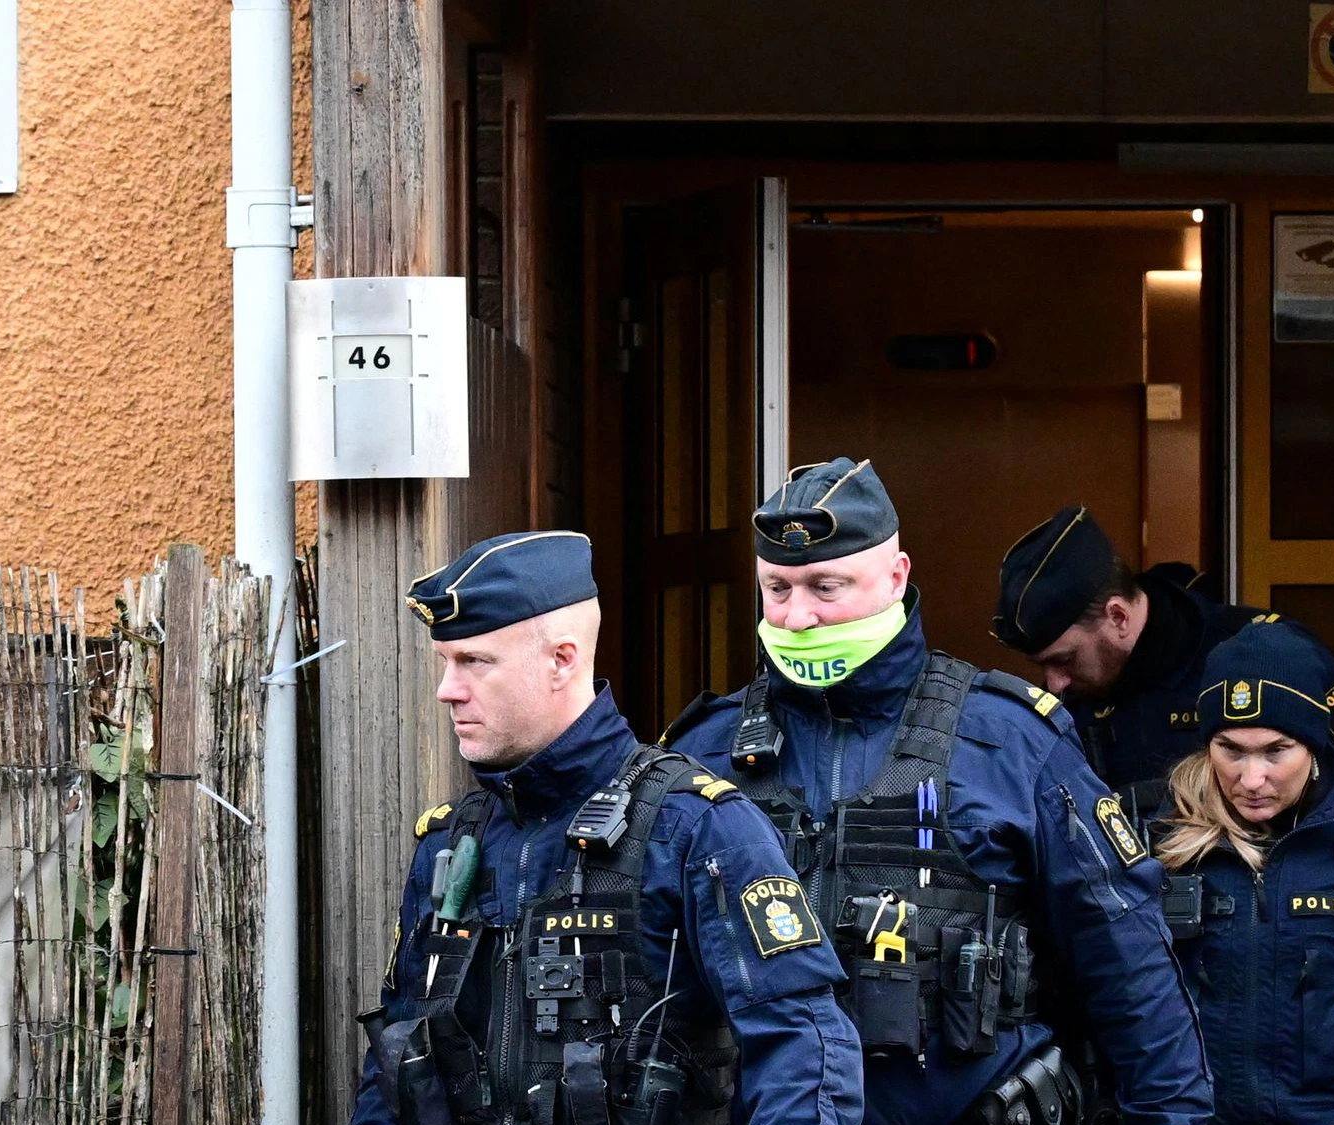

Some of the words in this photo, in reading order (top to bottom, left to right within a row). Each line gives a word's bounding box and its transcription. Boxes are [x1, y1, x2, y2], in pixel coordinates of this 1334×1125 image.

[348, 346, 391, 370] 46
[1170, 711, 1200, 725] POL
[745, 881, 798, 907] POLIS
[546, 913, 614, 932] POLIS
